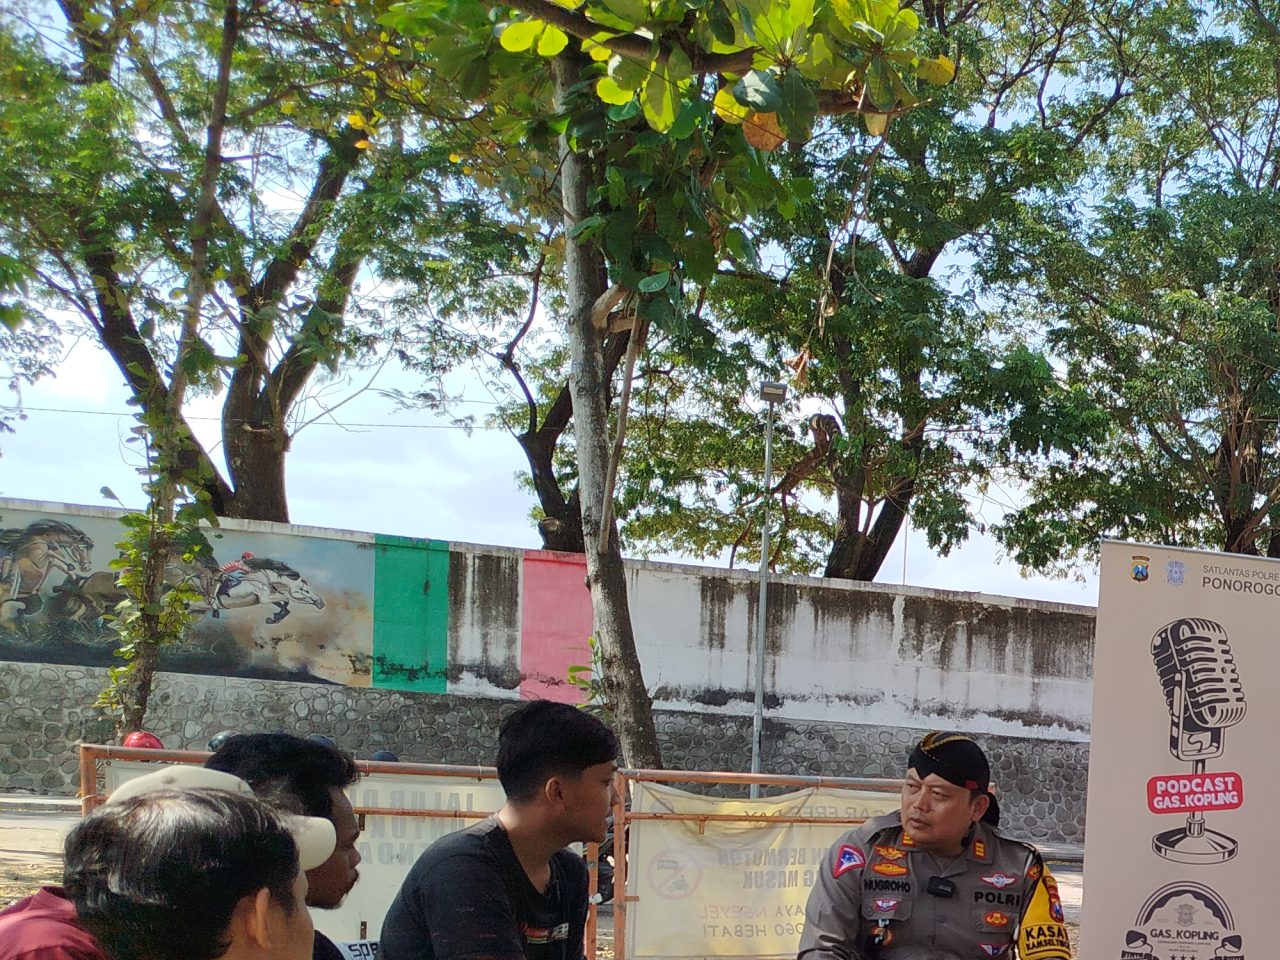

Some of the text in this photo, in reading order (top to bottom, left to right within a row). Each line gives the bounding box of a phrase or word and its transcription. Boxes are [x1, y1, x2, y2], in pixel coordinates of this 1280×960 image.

[1202, 565, 1250, 578] SATLANTAS
[1156, 776, 1236, 795] PODCAST
[1153, 792, 1239, 810] GAS_KOPLING
[863, 878, 911, 893] NUGROHO
[974, 890, 1021, 907] POLRI
[1150, 928, 1220, 941] GAS_KOPLING
